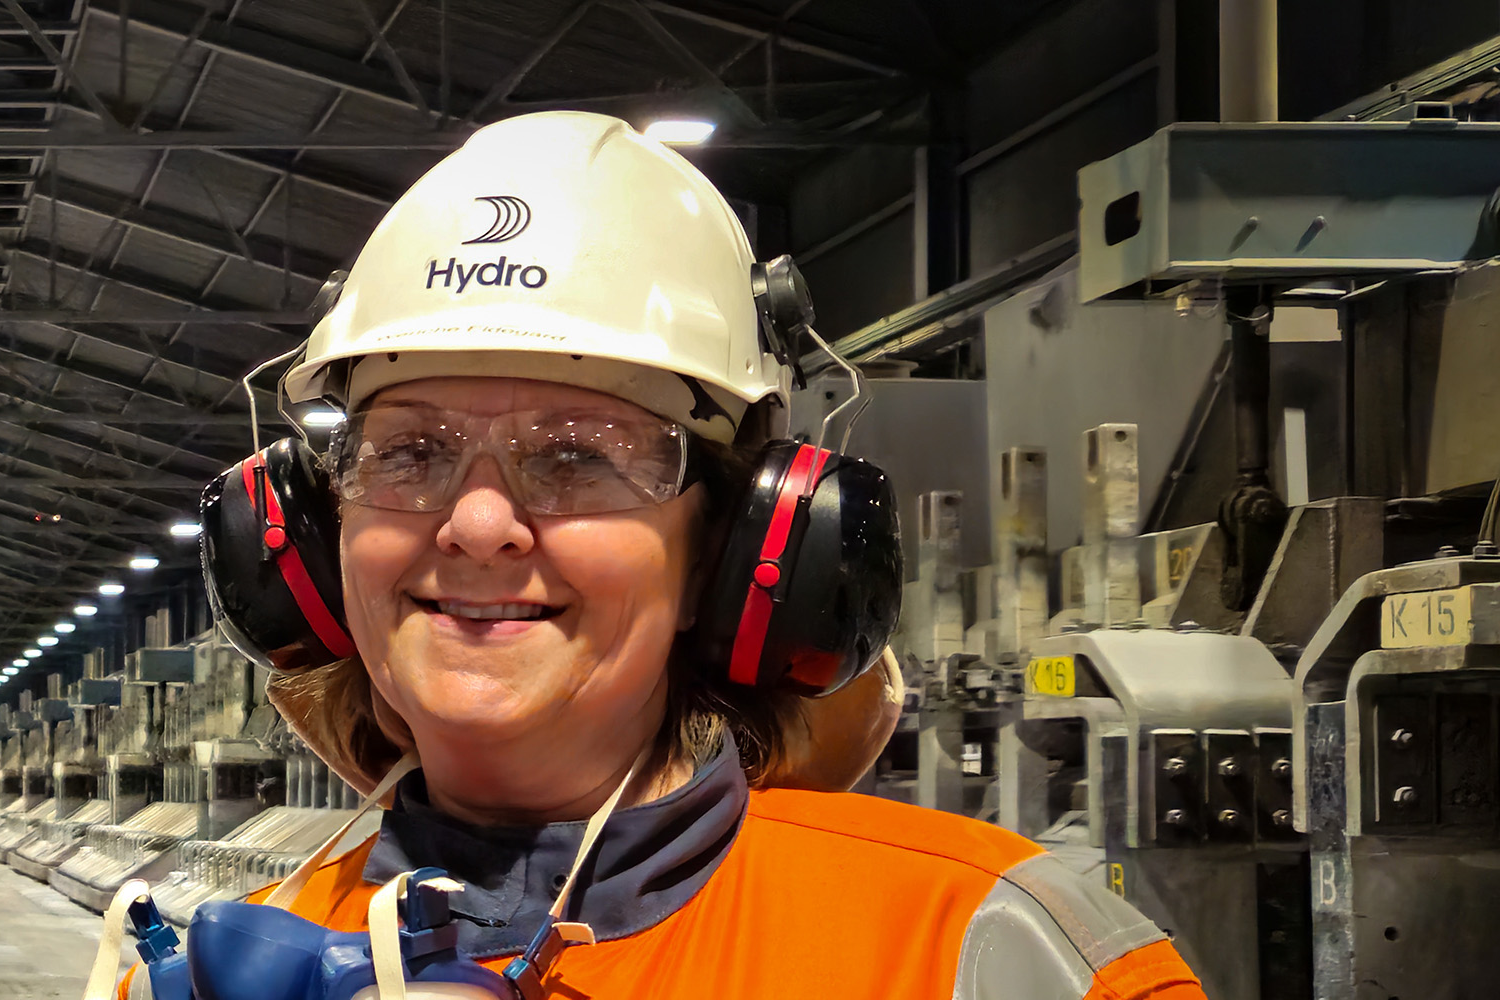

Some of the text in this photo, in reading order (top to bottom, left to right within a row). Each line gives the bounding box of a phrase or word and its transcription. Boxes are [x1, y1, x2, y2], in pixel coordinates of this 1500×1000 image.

[426, 255, 548, 294] Hydro
[1390, 594, 1455, 639] K 15
[1110, 862, 1125, 900] B
[1319, 859, 1337, 906] B
